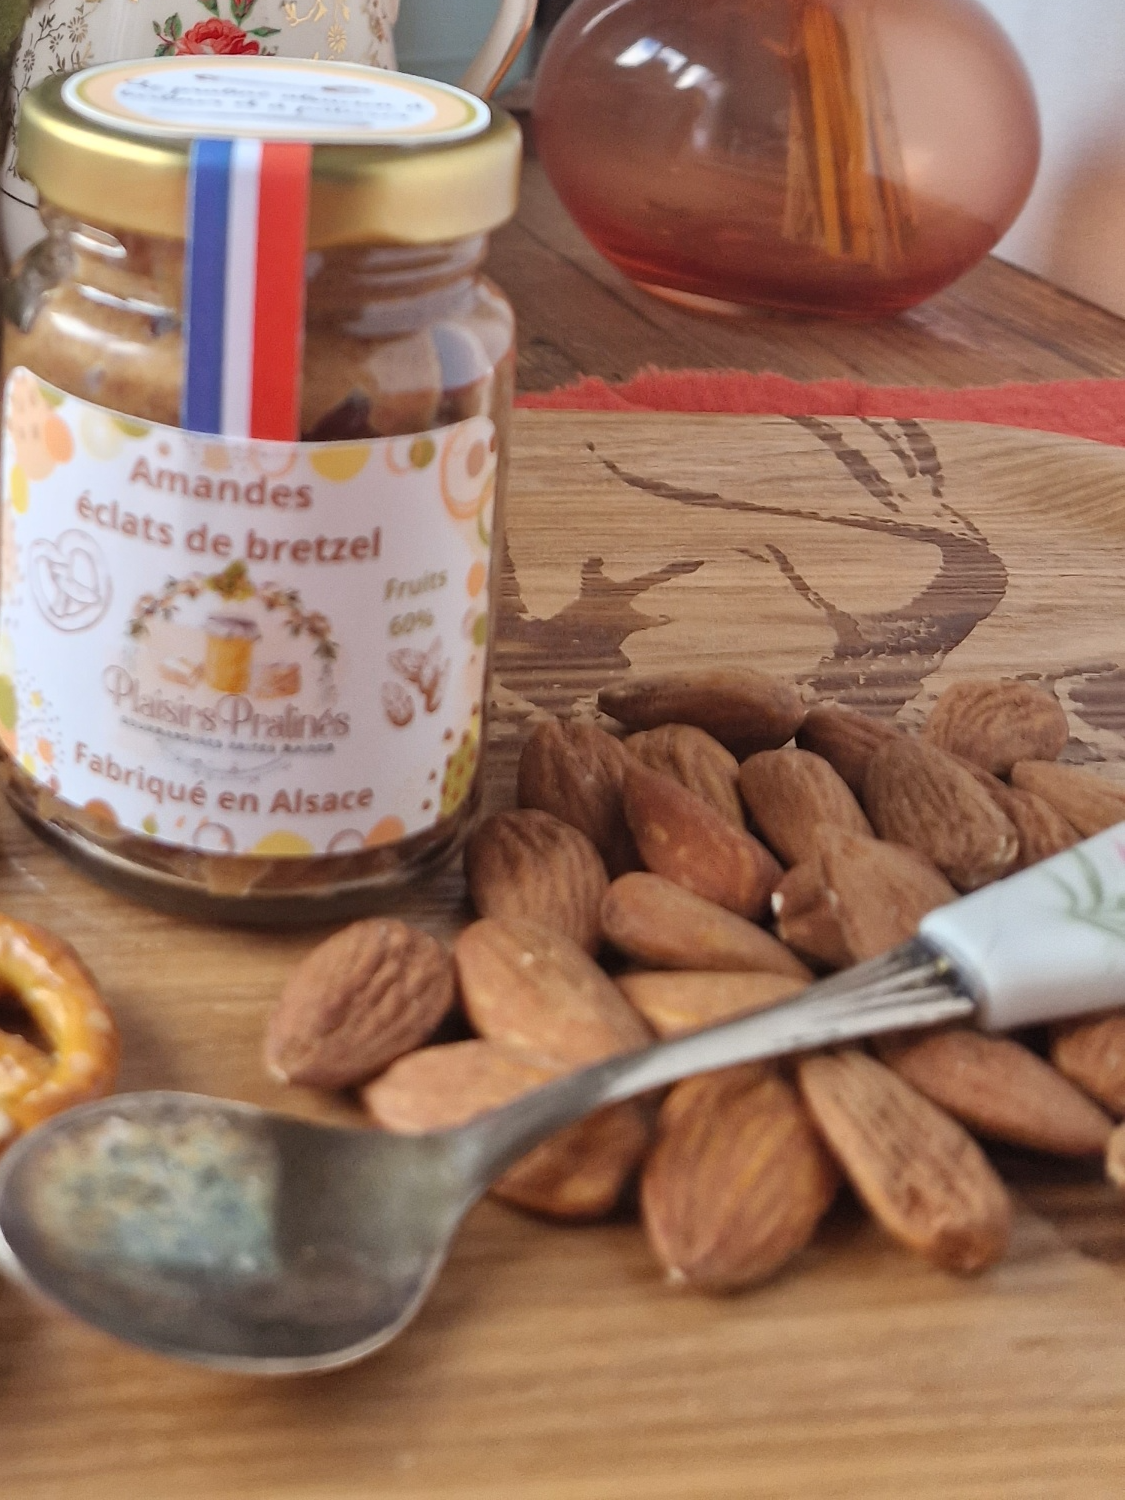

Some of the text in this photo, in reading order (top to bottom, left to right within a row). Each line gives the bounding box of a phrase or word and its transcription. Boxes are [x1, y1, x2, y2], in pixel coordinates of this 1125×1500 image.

[129, 455, 314, 510] Amandes
[75, 490, 383, 564] éclats de bretzel
[382, 569, 448, 603] Fruits
[74, 741, 374, 815] Fabriqué en Alsace
